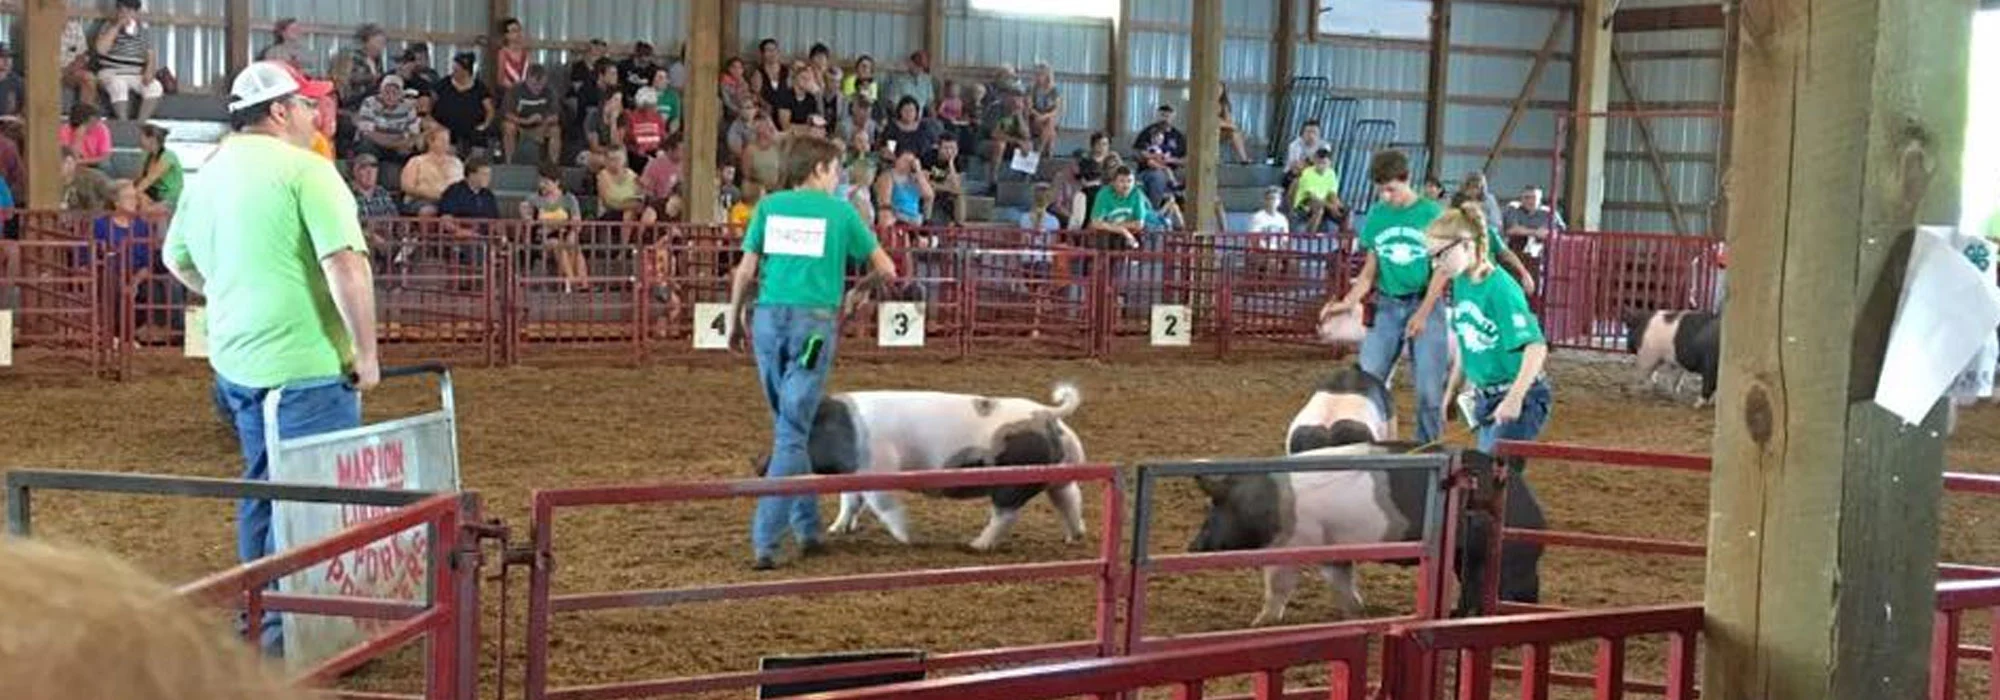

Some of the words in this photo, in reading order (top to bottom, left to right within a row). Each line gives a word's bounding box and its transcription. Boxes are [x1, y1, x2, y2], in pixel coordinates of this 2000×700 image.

[711, 312, 725, 336] 4
[894, 313, 910, 336] 3
[1164, 315, 1178, 337] 2
[337, 441, 403, 486] MARION
